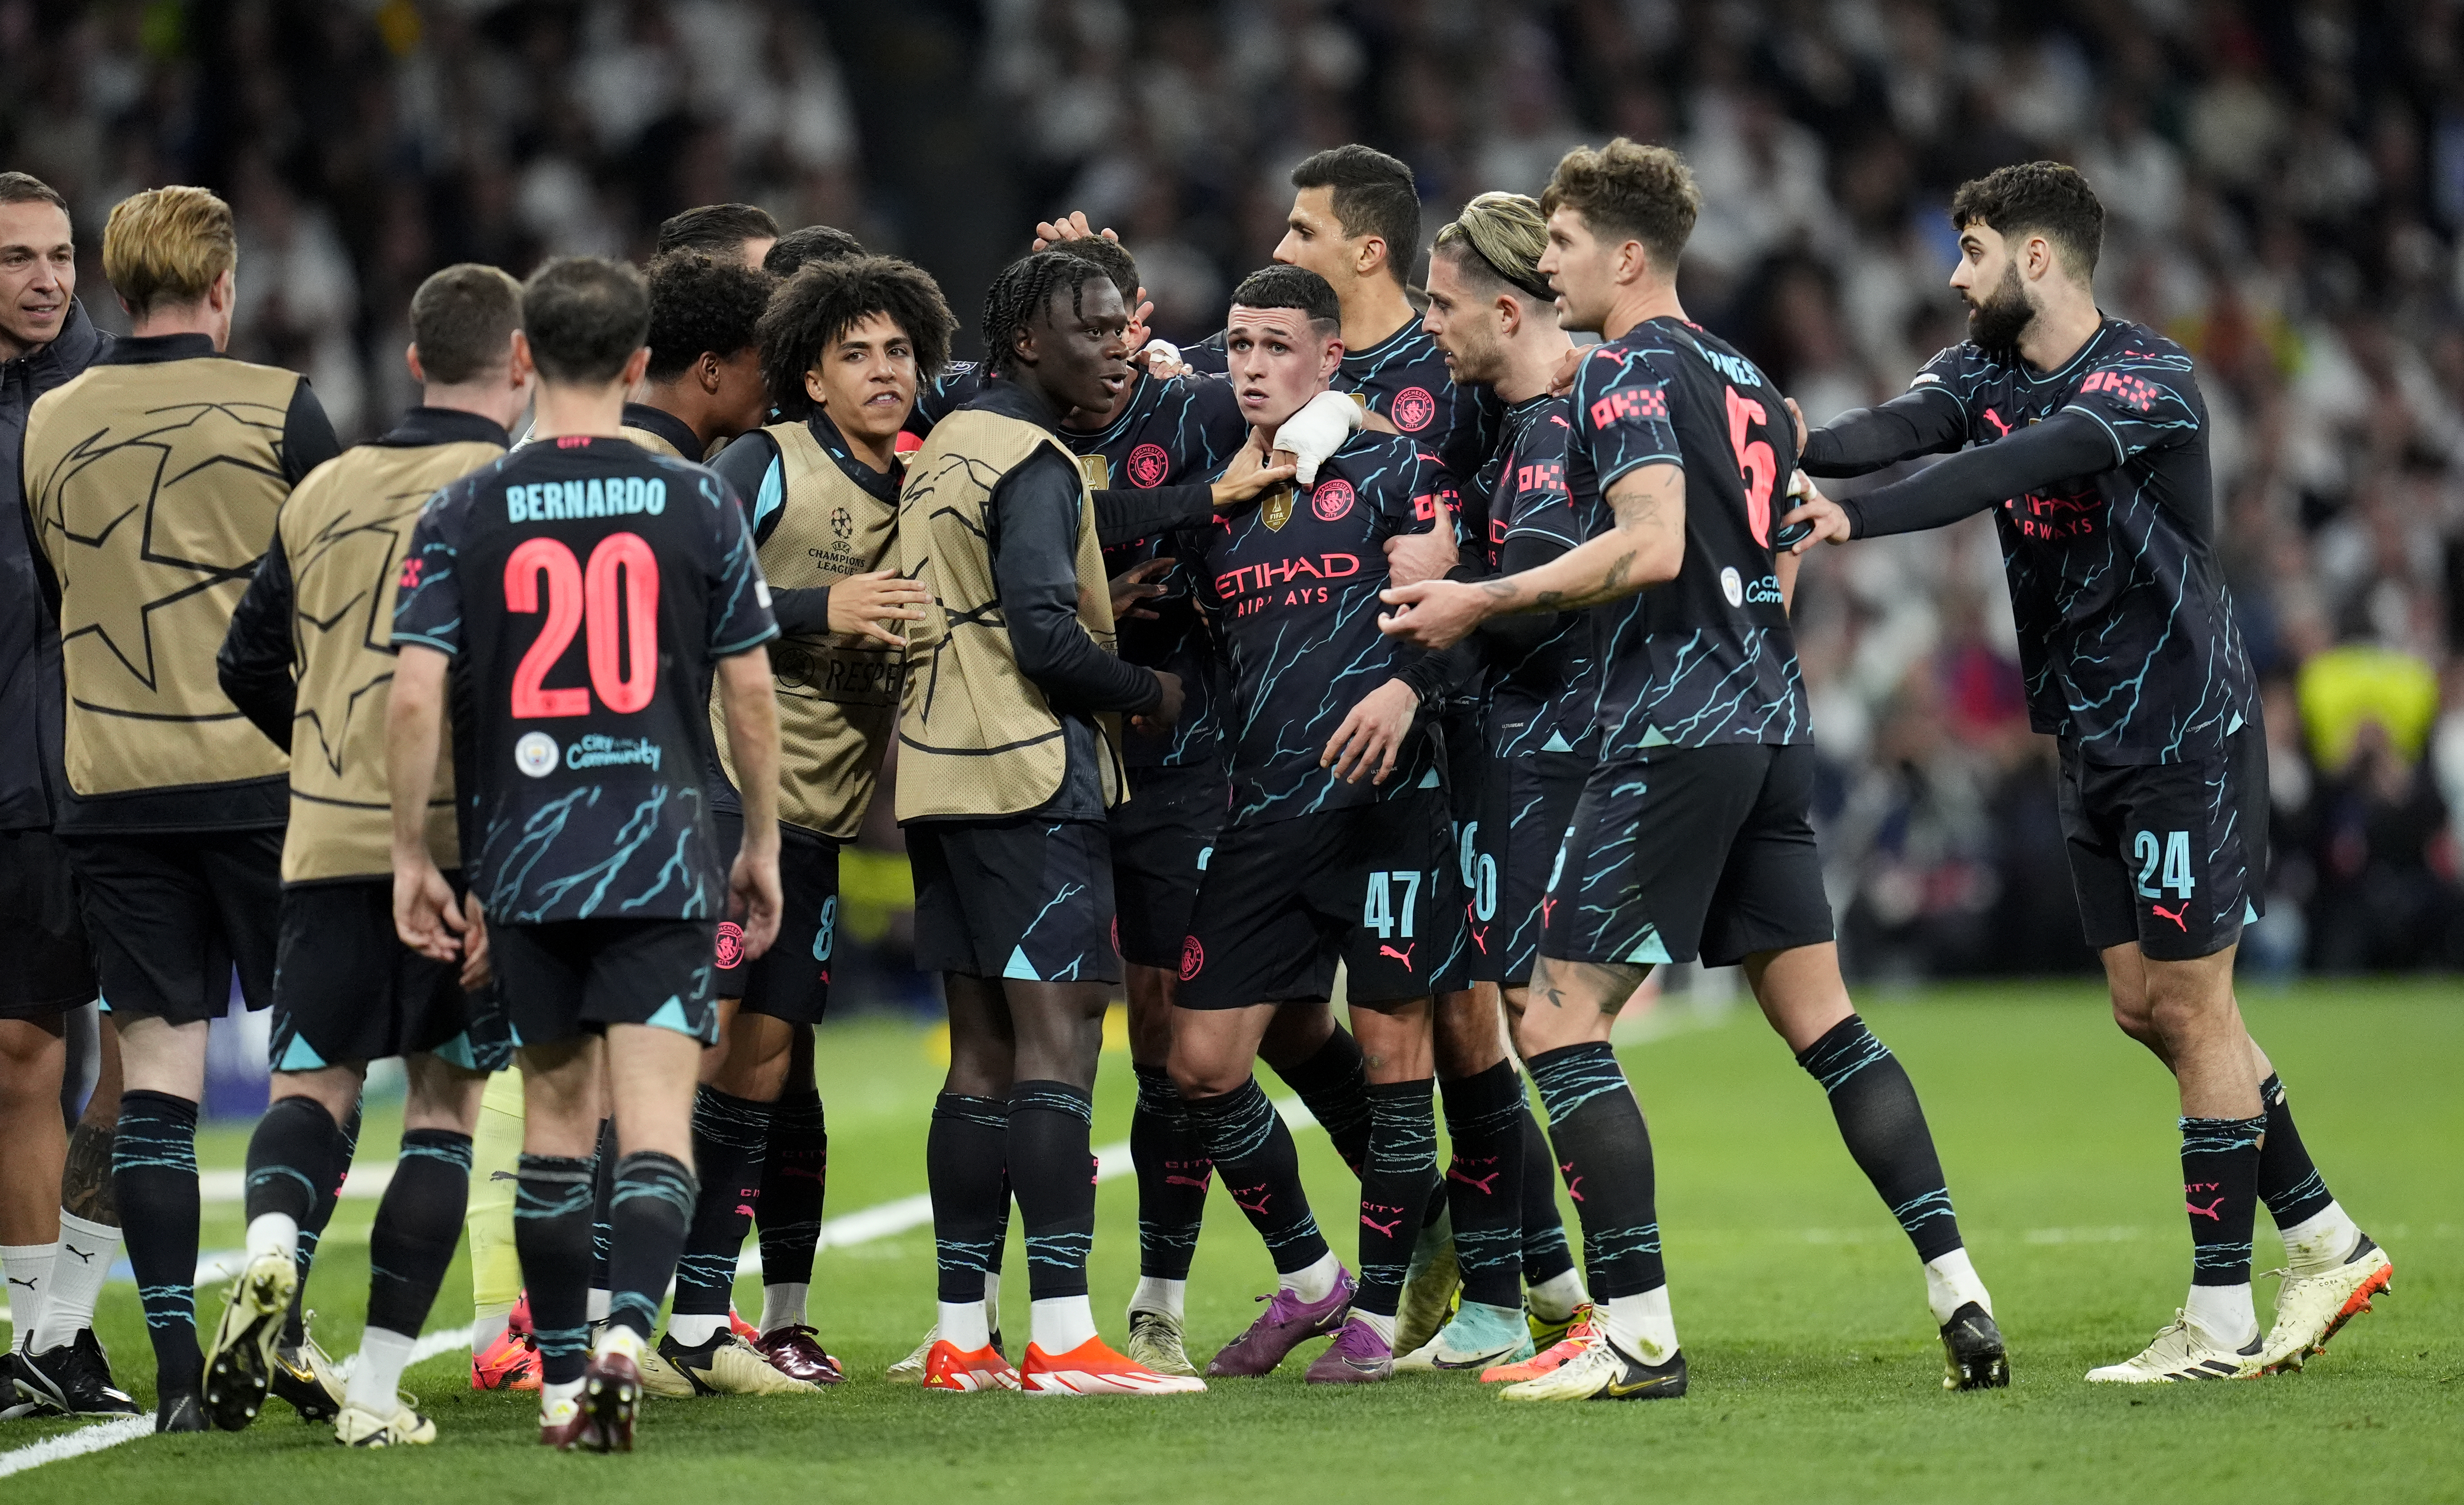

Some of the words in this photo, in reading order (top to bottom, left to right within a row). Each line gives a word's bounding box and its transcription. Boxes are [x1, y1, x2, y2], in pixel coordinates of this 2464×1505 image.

[1397, 390, 1430, 405] MANCHESTER
[2080, 372, 2157, 412] OKX
[1591, 390, 1666, 430] OKX
[1132, 447, 1163, 464] MANCHESTER
[1726, 385, 1776, 549] 5
[1318, 482, 1350, 496] MANCHESTER
[1518, 465, 1566, 493] OK
[506, 477, 666, 524] BERNARDO
[808, 548, 866, 568] CHAMPIONS
[832, 543, 851, 553] UEFA
[817, 560, 855, 576] LEAGUE
[1215, 553, 1360, 599] ETIHAD
[1238, 587, 1328, 617] AIRAYS
[504, 532, 660, 719] 20
[2134, 830, 2195, 899] 24
[1364, 871, 1421, 939] 47
[812, 895, 837, 961] 8
[1228, 1183, 1266, 1196] ITY
[1362, 1200, 1404, 1213] CITY
